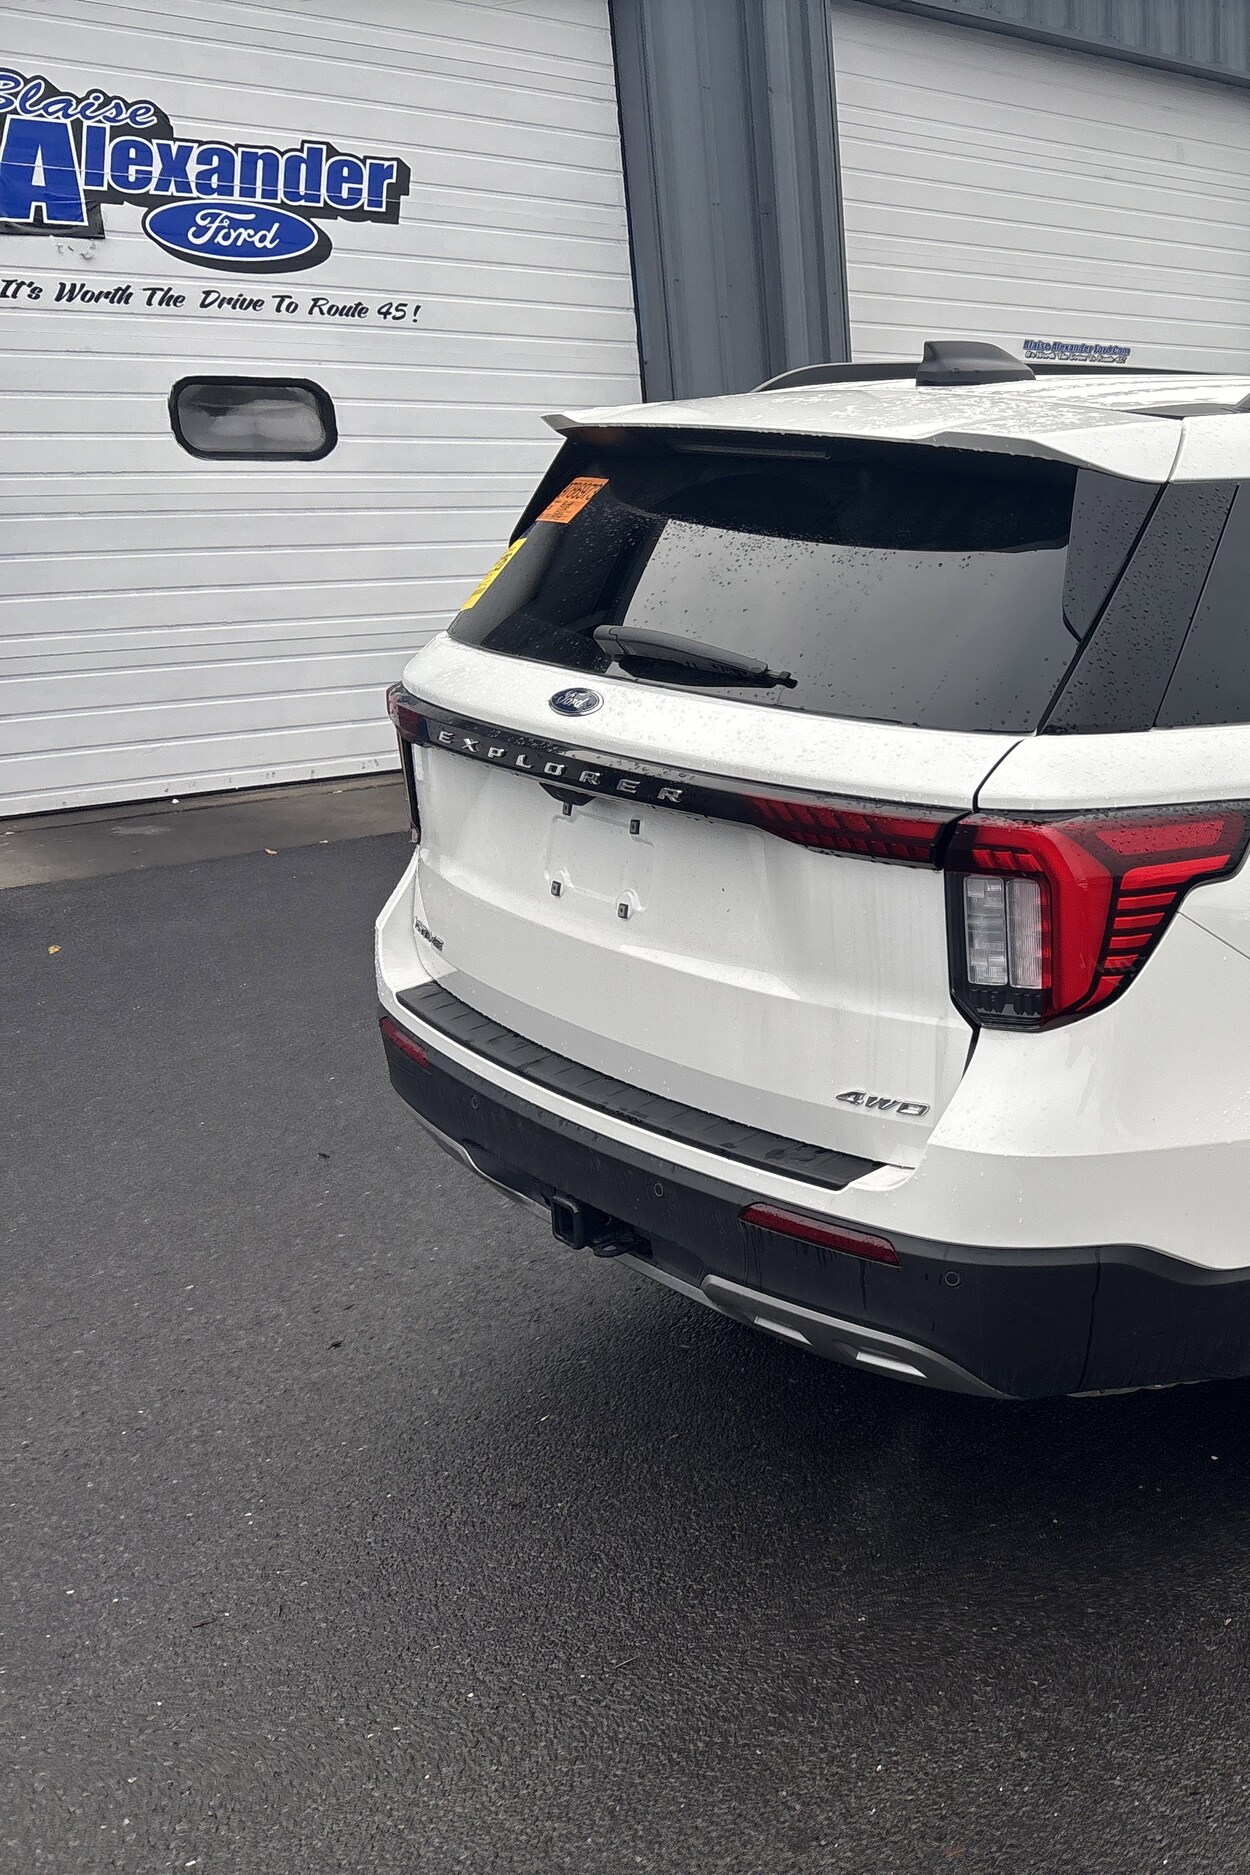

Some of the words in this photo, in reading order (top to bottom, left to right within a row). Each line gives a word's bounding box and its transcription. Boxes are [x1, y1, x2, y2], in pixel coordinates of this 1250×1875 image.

[0, 72, 157, 128] Blaise
[0, 114, 397, 226] Alexander
[187, 208, 280, 249] Ford
[0, 278, 43, 300] It's
[54, 281, 134, 305] Worth
[142, 286, 187, 308] The
[199, 289, 266, 312] Drive
[271, 294, 299, 314] To
[307, 296, 370, 319] Route
[438, 730, 683, 803] EXPLORER
[835, 1090, 931, 1116] 4WD
